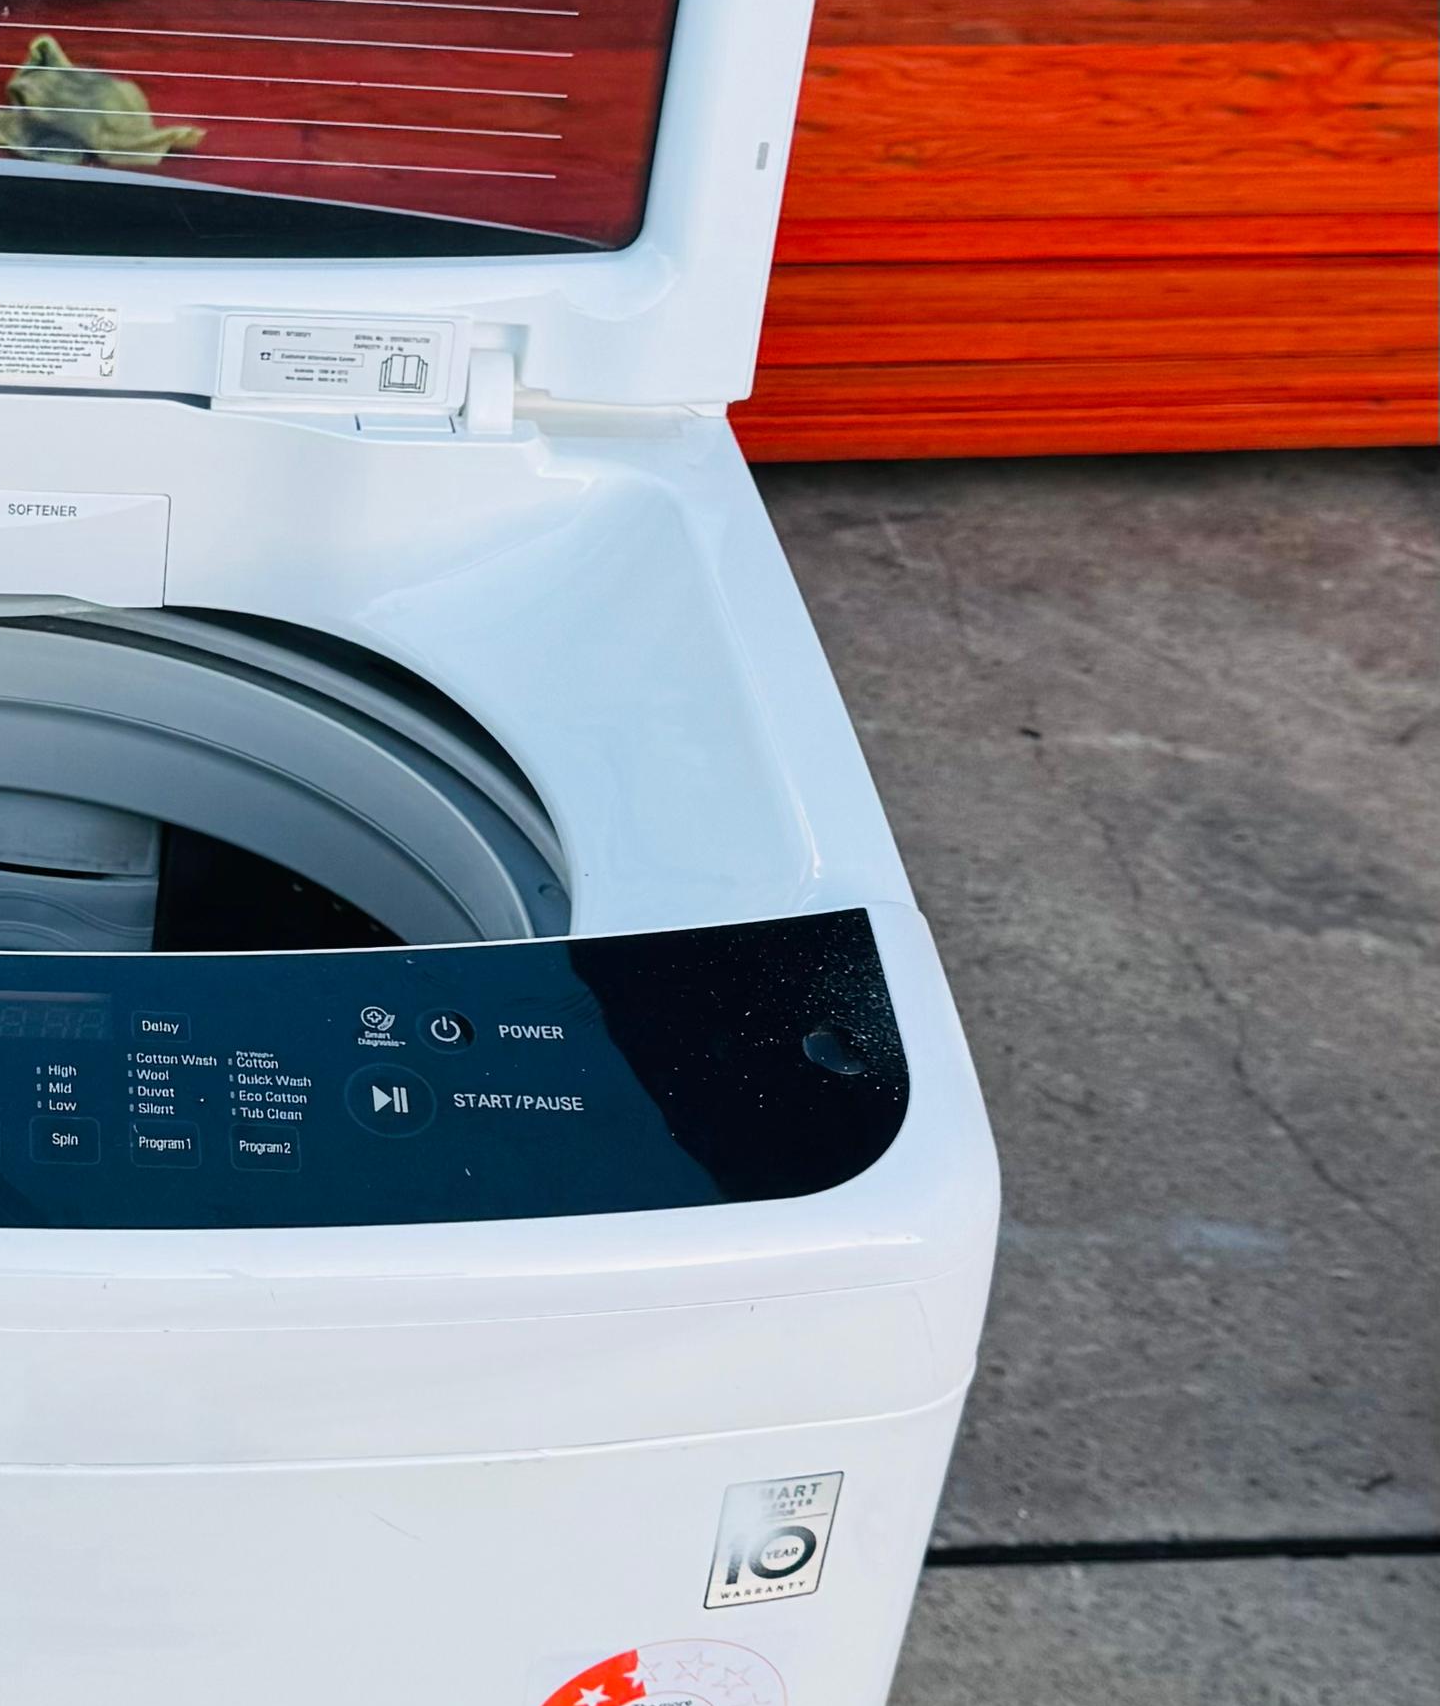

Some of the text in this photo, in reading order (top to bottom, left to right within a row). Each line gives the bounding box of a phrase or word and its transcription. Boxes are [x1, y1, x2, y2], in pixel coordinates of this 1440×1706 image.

[8, 503, 78, 517] SOFTENER
[498, 1024, 565, 1039] POWER
[136, 1052, 217, 1066] Cotton Wash
[236, 1057, 279, 1069] Cotton
[48, 1064, 78, 1077] High
[136, 1069, 170, 1080] Wool
[237, 1073, 312, 1087] Quick Wash
[48, 1082, 72, 1094] Mid
[137, 1085, 175, 1098] Duvet
[239, 1090, 308, 1104] Eco Cotton
[453, 1093, 585, 1111] START/PAUSE
[48, 1099, 77, 1111] Low
[240, 1106, 264, 1119] Tub
[51, 1132, 79, 1147] Spin
[138, 1135, 185, 1150] Program
[239, 1140, 292, 1155] Program 2
[725, 1525, 817, 1585] 10
[765, 1547, 800, 1560] YEAR
[720, 1580, 807, 1600] WARRANTY
